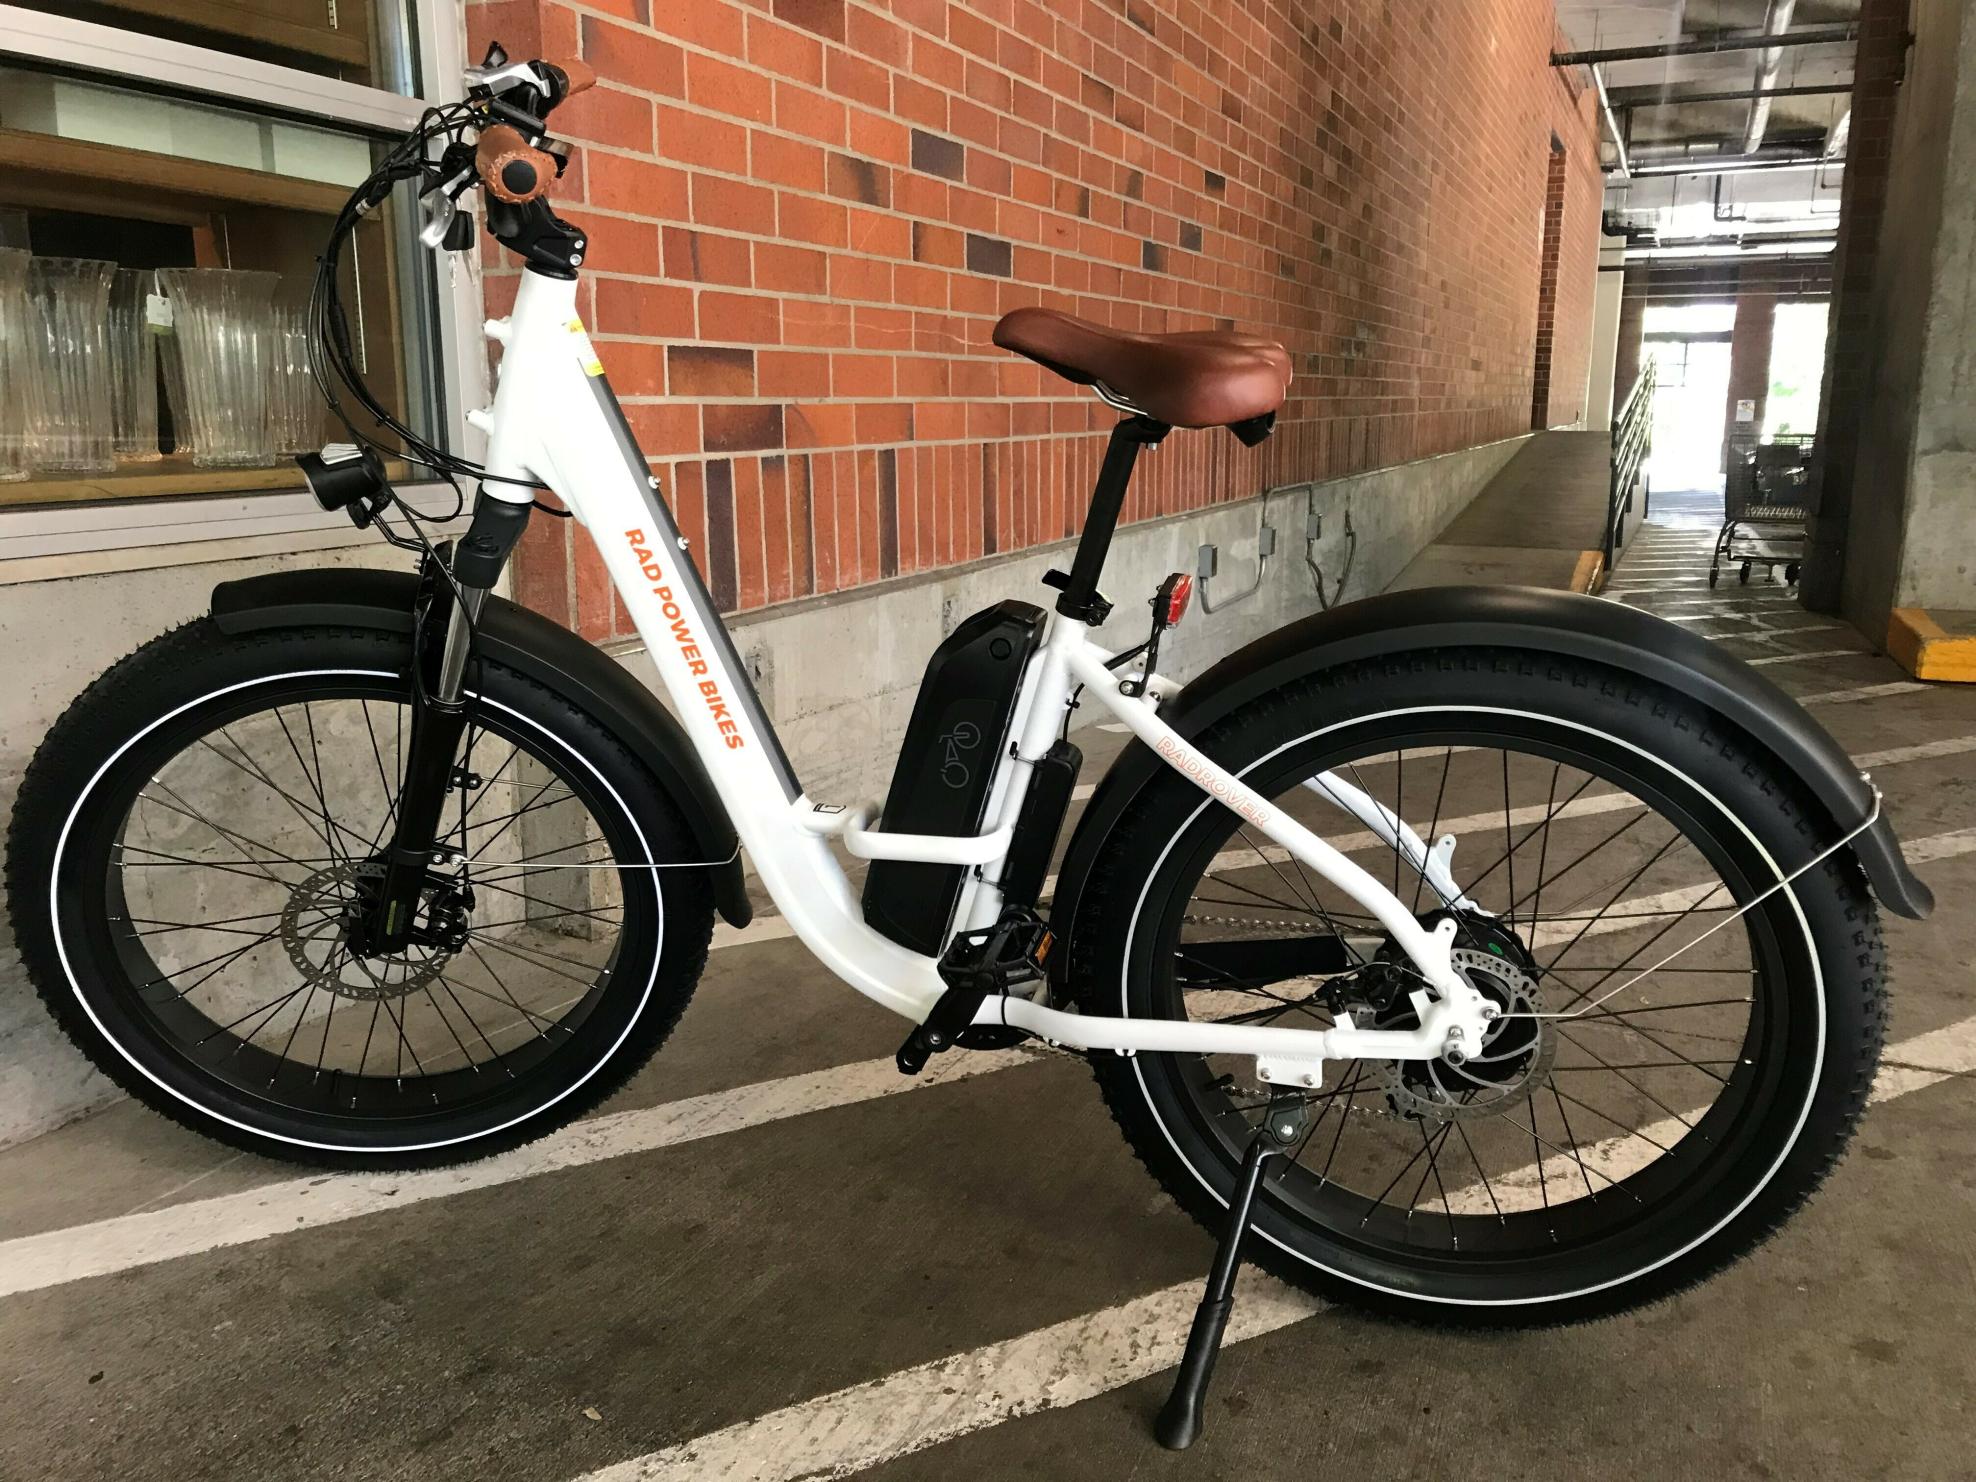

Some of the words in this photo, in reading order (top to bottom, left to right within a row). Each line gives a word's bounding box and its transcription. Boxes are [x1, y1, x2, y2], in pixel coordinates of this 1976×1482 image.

[625, 528, 662, 582] RAD
[653, 586, 708, 677] POWER
[698, 681, 745, 750] BIKES
[1156, 736, 1270, 827] RADROVER
